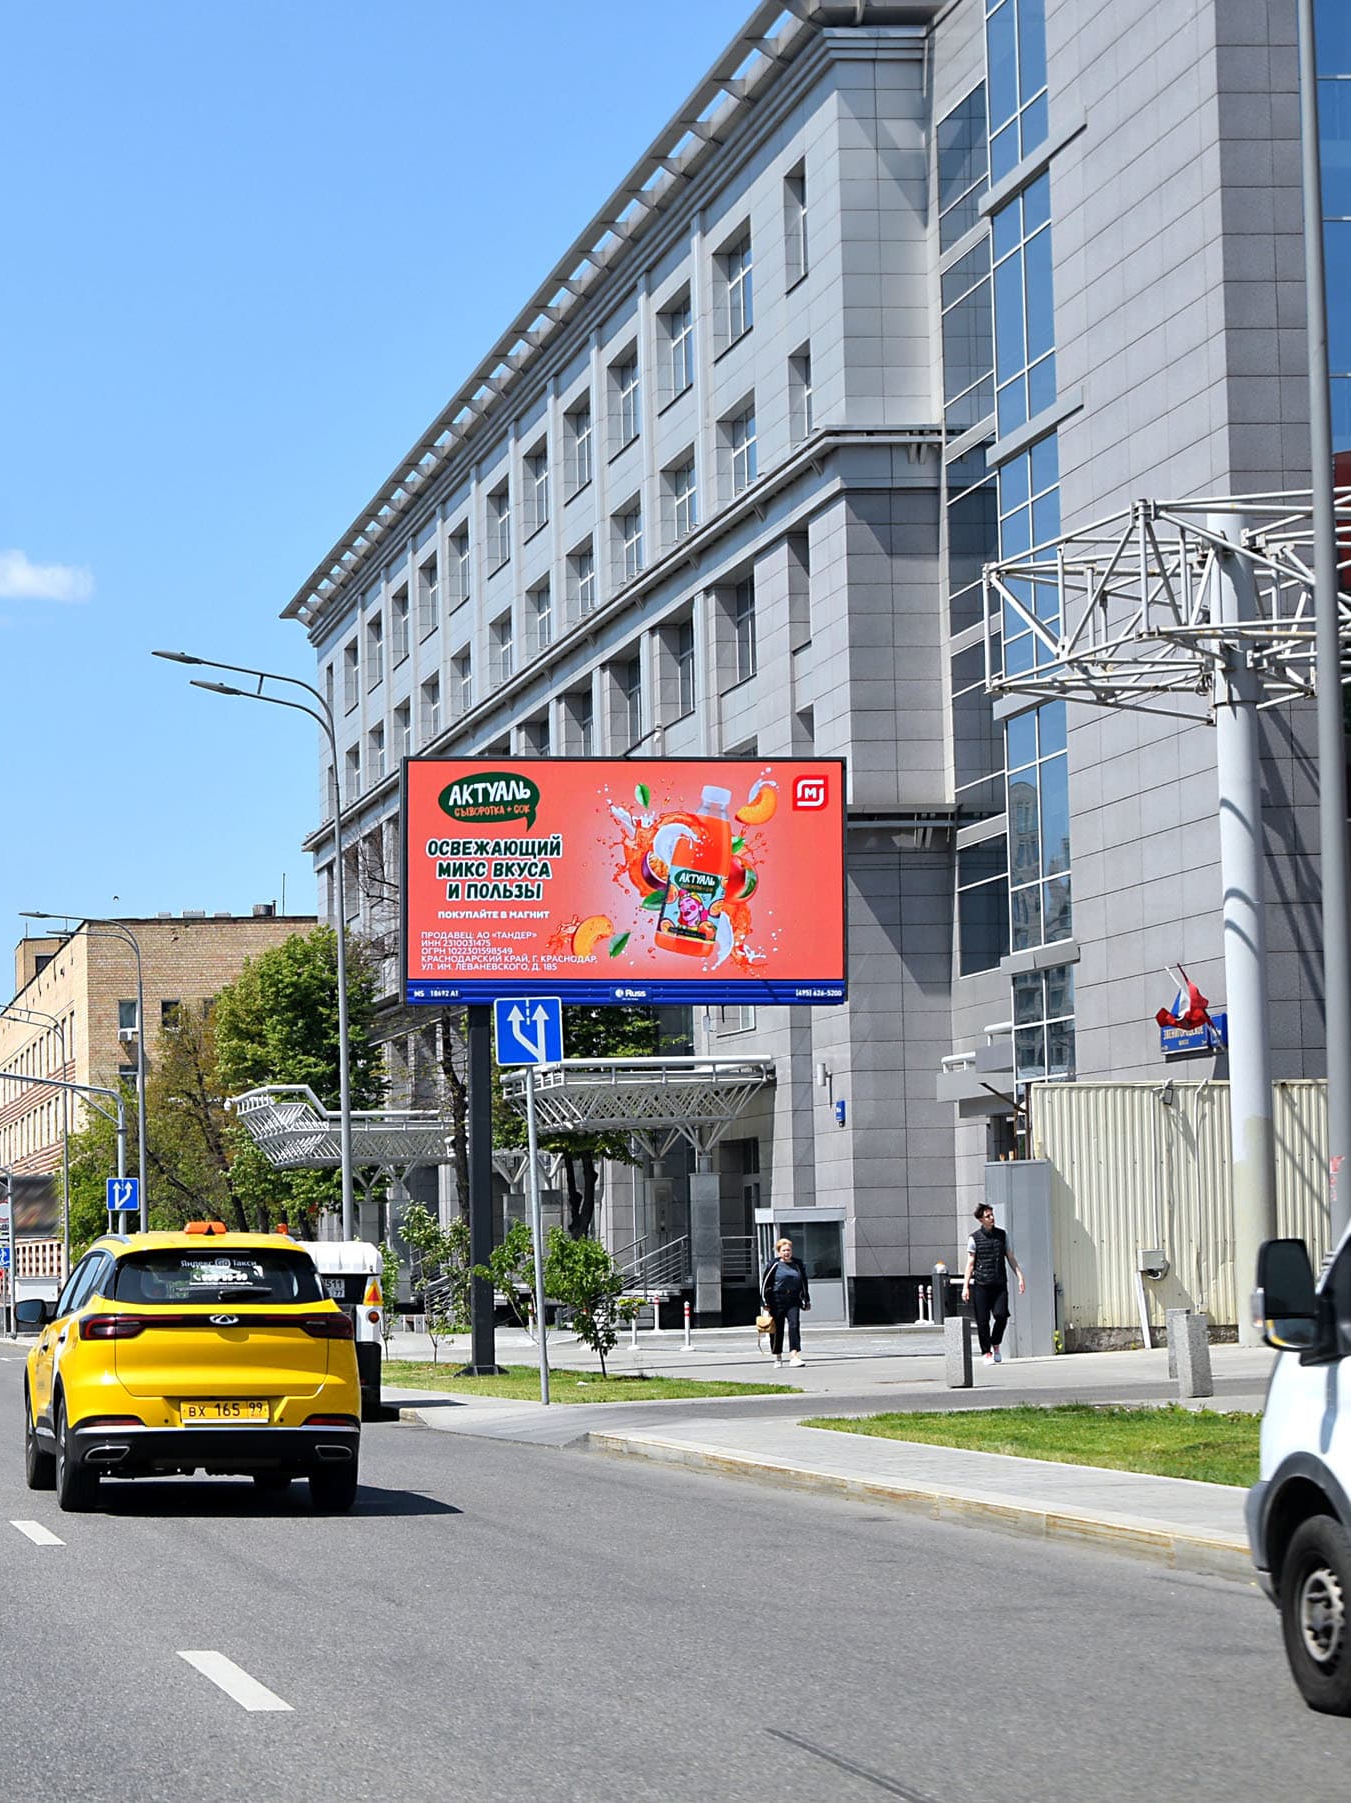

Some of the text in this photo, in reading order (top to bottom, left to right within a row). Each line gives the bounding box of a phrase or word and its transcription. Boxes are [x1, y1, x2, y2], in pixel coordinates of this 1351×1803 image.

[448, 780, 531, 806] АКТУАЛЬ
[454, 805, 505, 817] СЫВОРОТКА
[513, 804, 530, 814] СОК
[427, 835, 562, 859] ОСВЕЖАЮЩИЙ
[437, 861, 551, 878] МИКС ВКУСА
[678, 872, 716, 886] АКТУАЛЬ
[448, 883, 541, 899] И ПОЛЬЗЫ
[438, 909, 550, 919] ПОКУПАЙТЕ В МАГНИТ
[477, 931, 490, 939] АО
[491, 931, 537, 939] «ТАНДЕР»
[421, 939, 491, 947] ИНН 2310031475
[421, 947, 446, 955] ОГРН
[421, 954, 502, 963] КРАСНОДАРСКИЙ
[504, 953, 531, 963] КРАЙ,
[540, 955, 598, 963] КРАСНОДАР,
[455, 963, 530, 971] ЛЕВАНЕВСКОГО,
[625, 989, 647, 998] Russ
[233, 1259, 257, 1267] Такси
[214, 1402, 241, 1417] 165
[249, 1402, 263, 1412] 99
